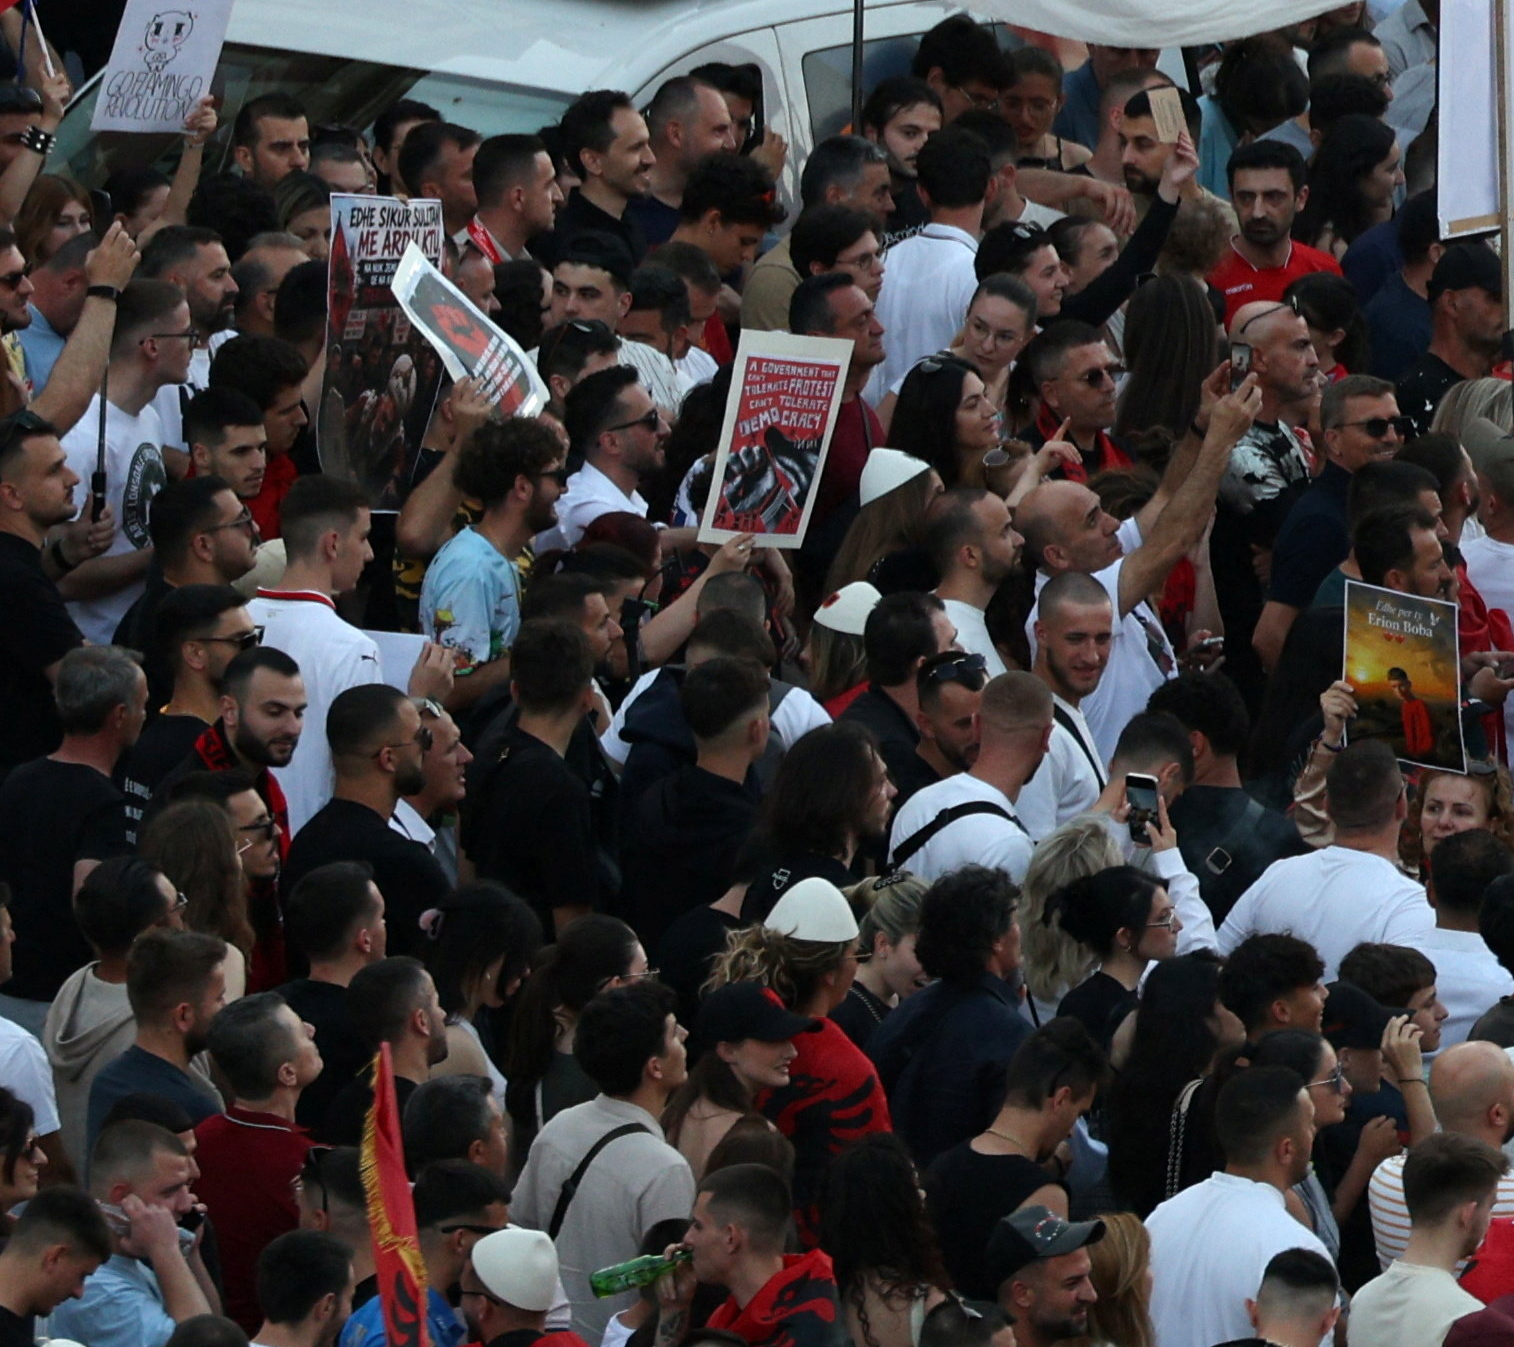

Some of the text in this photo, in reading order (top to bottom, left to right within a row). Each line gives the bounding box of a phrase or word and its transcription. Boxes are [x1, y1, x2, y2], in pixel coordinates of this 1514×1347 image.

[350, 206, 376, 228] EDHE
[378, 206, 411, 229] SIKUR
[358, 229, 378, 257] ME
[749, 363, 819, 378] A GOVERNMENT
[745, 378, 835, 397] TOLERATE PROTEST
[779, 395, 829, 411] TOLERATE
[1368, 611, 1433, 639] Erion Boba
